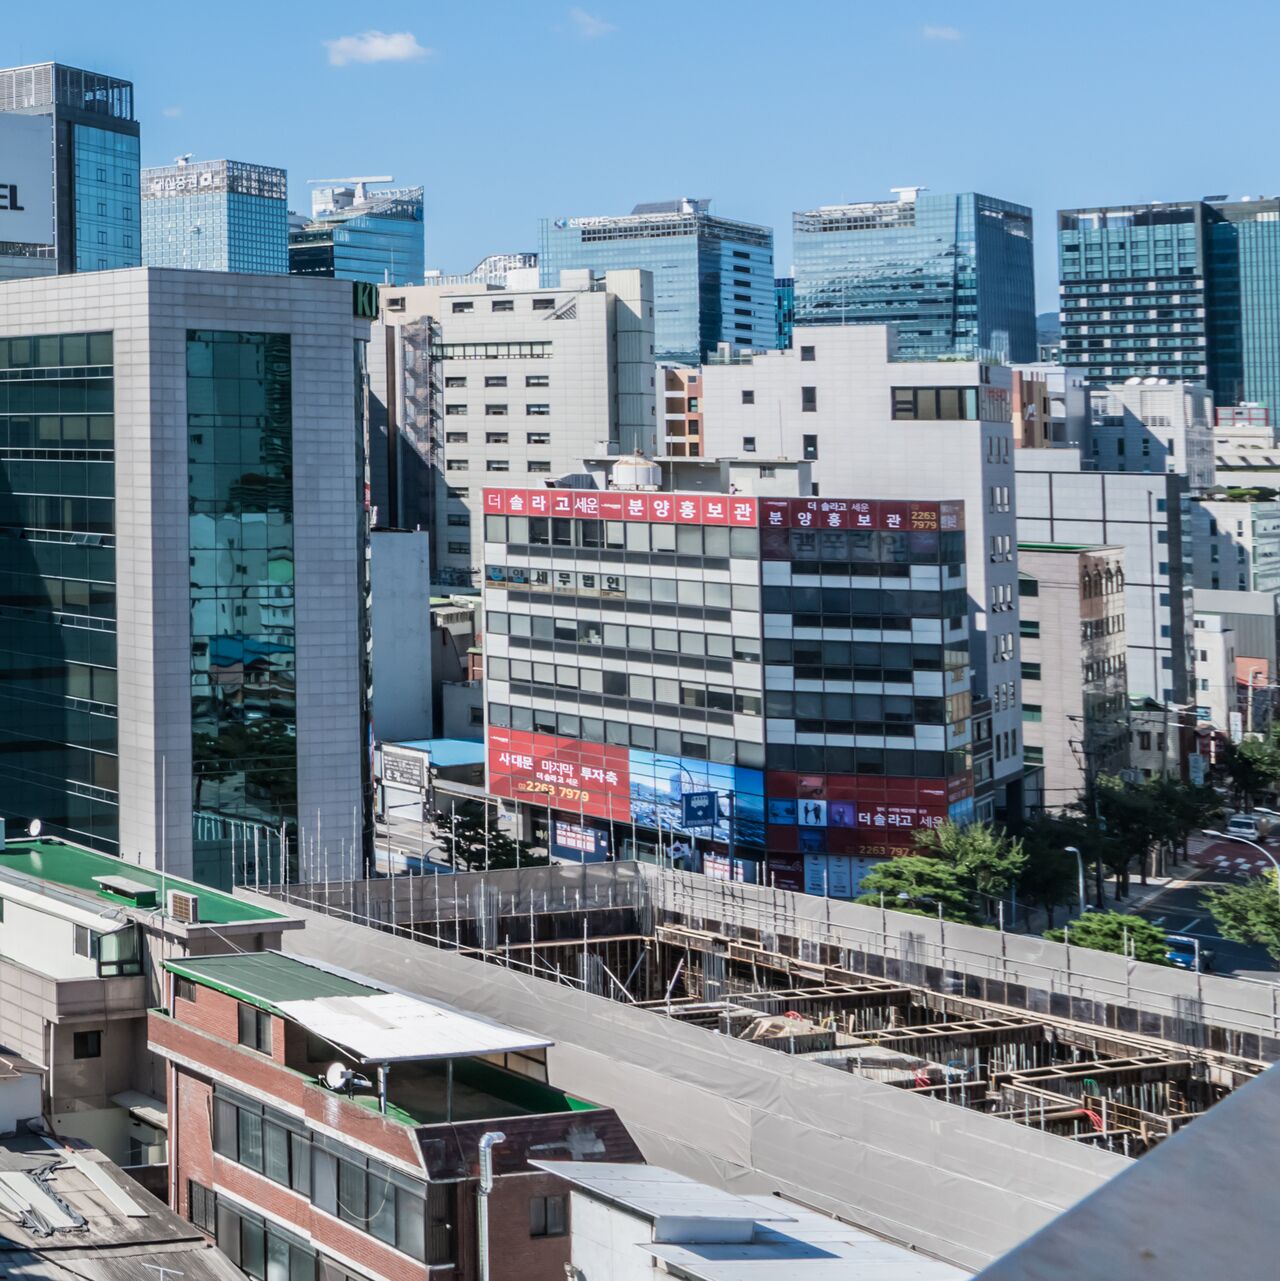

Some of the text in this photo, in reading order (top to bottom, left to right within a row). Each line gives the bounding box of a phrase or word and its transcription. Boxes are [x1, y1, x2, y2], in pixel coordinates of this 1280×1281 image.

[151, 175, 197, 190] 대신증권
[488, 494, 501, 509] 더
[574, 497, 599, 514] 세운
[627, 497, 752, 522] 분양홍보관
[807, 502, 817, 511] 더
[851, 503, 870, 512] 세운
[768, 511, 901, 529] 분양홍보관
[911, 511, 936, 520] 2263
[911, 520, 937, 529] 7979
[499, 752, 618, 786] 사대문 마지막 투자축
[536, 772, 544, 780] 더
[526, 781, 556, 796] 2263
[559, 786, 590, 802] 7979
[858, 813, 871, 825] 더
[860, 845, 886, 855] 2263
